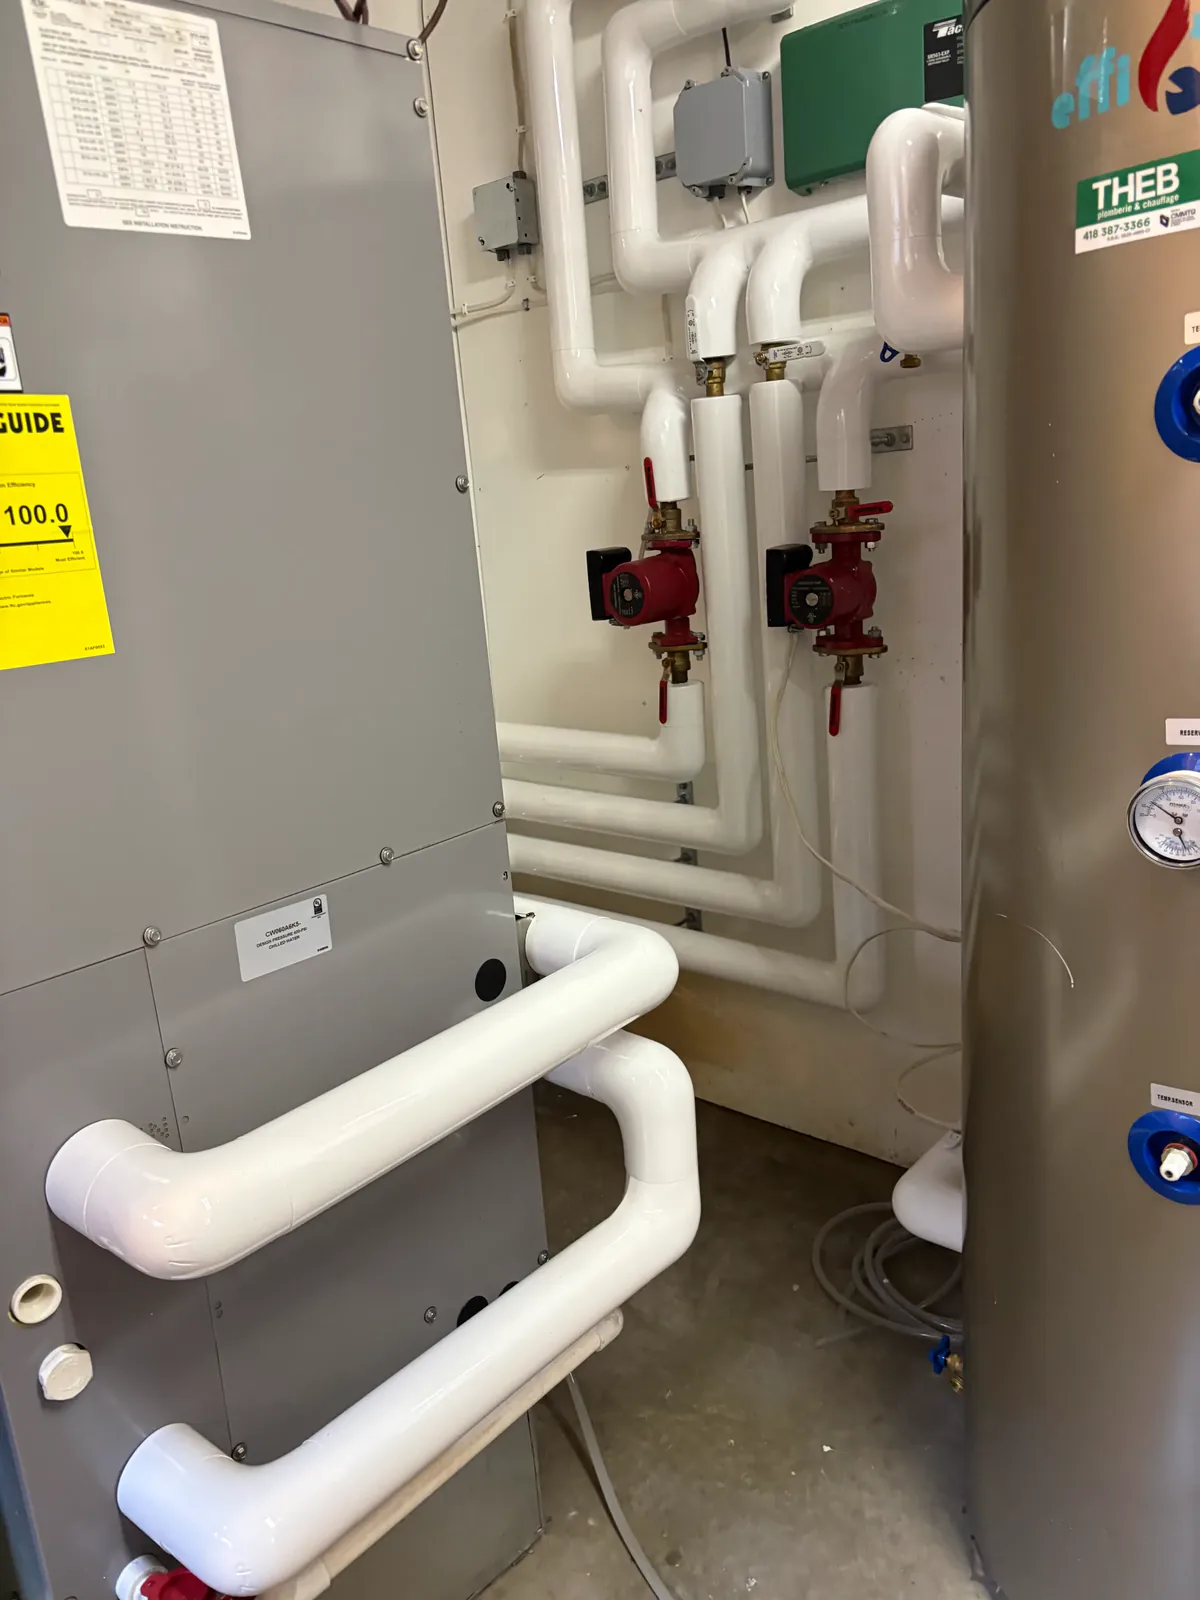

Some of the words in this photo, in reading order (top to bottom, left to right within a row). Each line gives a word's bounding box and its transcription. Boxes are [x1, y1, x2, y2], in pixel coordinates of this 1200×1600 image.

[932, 19, 963, 38] Tac
[1092, 162, 1180, 210] THEB
[1097, 204, 1132, 220] plomberie
[1134, 202, 1141, 210] &
[1142, 194, 1180, 208] chauffage
[1083, 229, 1099, 240] 418
[1101, 217, 1151, 236] 387-3366
[0, 412, 65, 434] GUIDE
[4, 503, 69, 526] 100.0
[268, 940, 286, 950] CHILLED
[286, 935, 300, 943] WATER
[272, 931, 293, 942] PRESSURE
